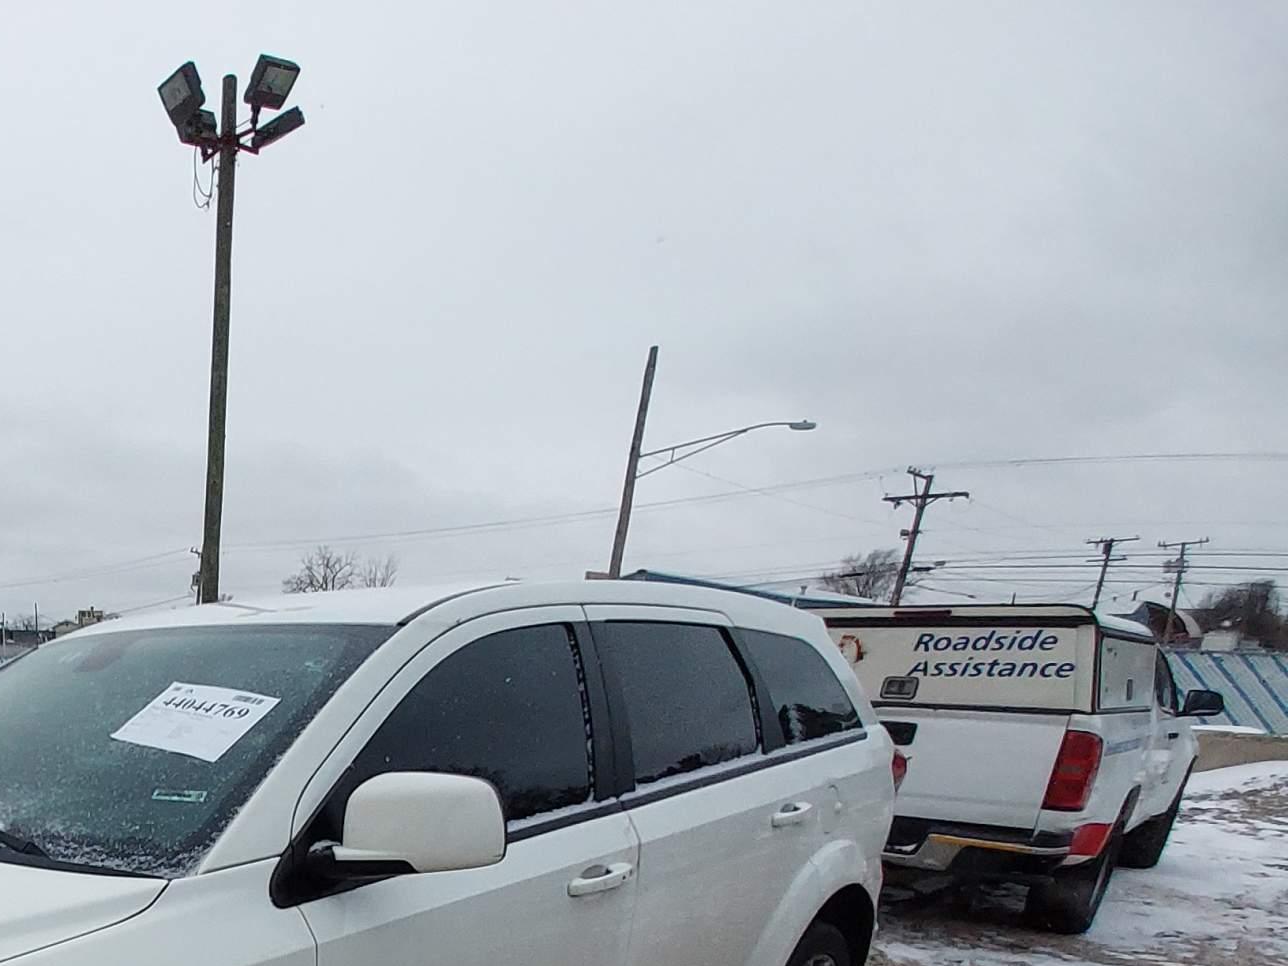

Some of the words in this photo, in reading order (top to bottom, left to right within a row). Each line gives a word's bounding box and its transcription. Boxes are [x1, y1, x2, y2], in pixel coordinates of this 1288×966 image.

[913, 630, 1058, 652] Roadside
[906, 657, 1076, 678] Assistance
[163, 697, 250, 720] 44044769
